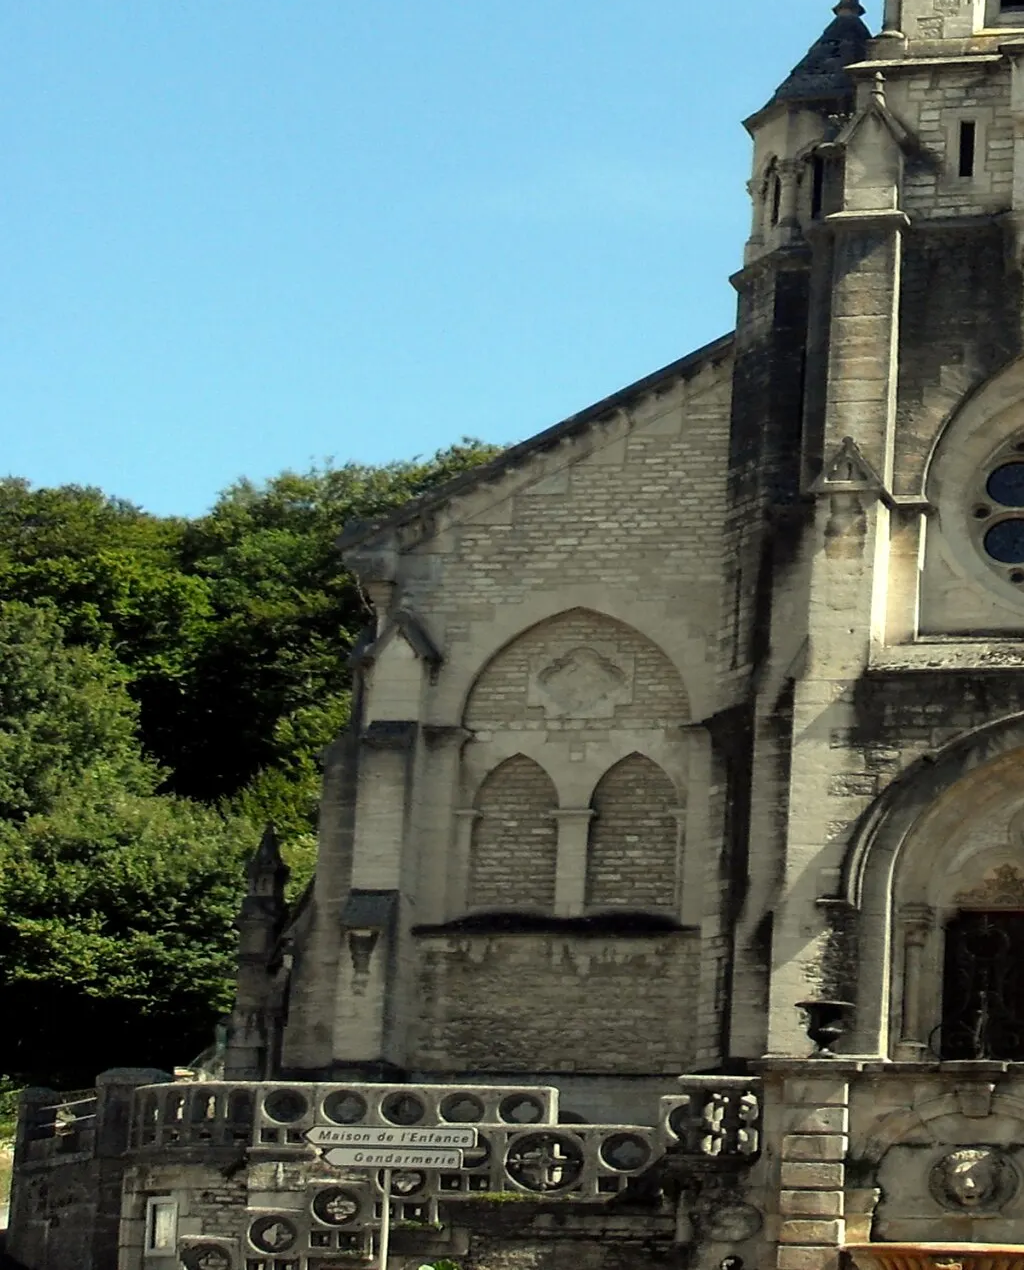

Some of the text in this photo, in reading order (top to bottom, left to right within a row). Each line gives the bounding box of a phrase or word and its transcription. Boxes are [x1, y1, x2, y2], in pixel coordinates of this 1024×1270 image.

[318, 1130, 469, 1143] Maison de l'Enfance
[354, 1152, 456, 1165] Gendarmerie
